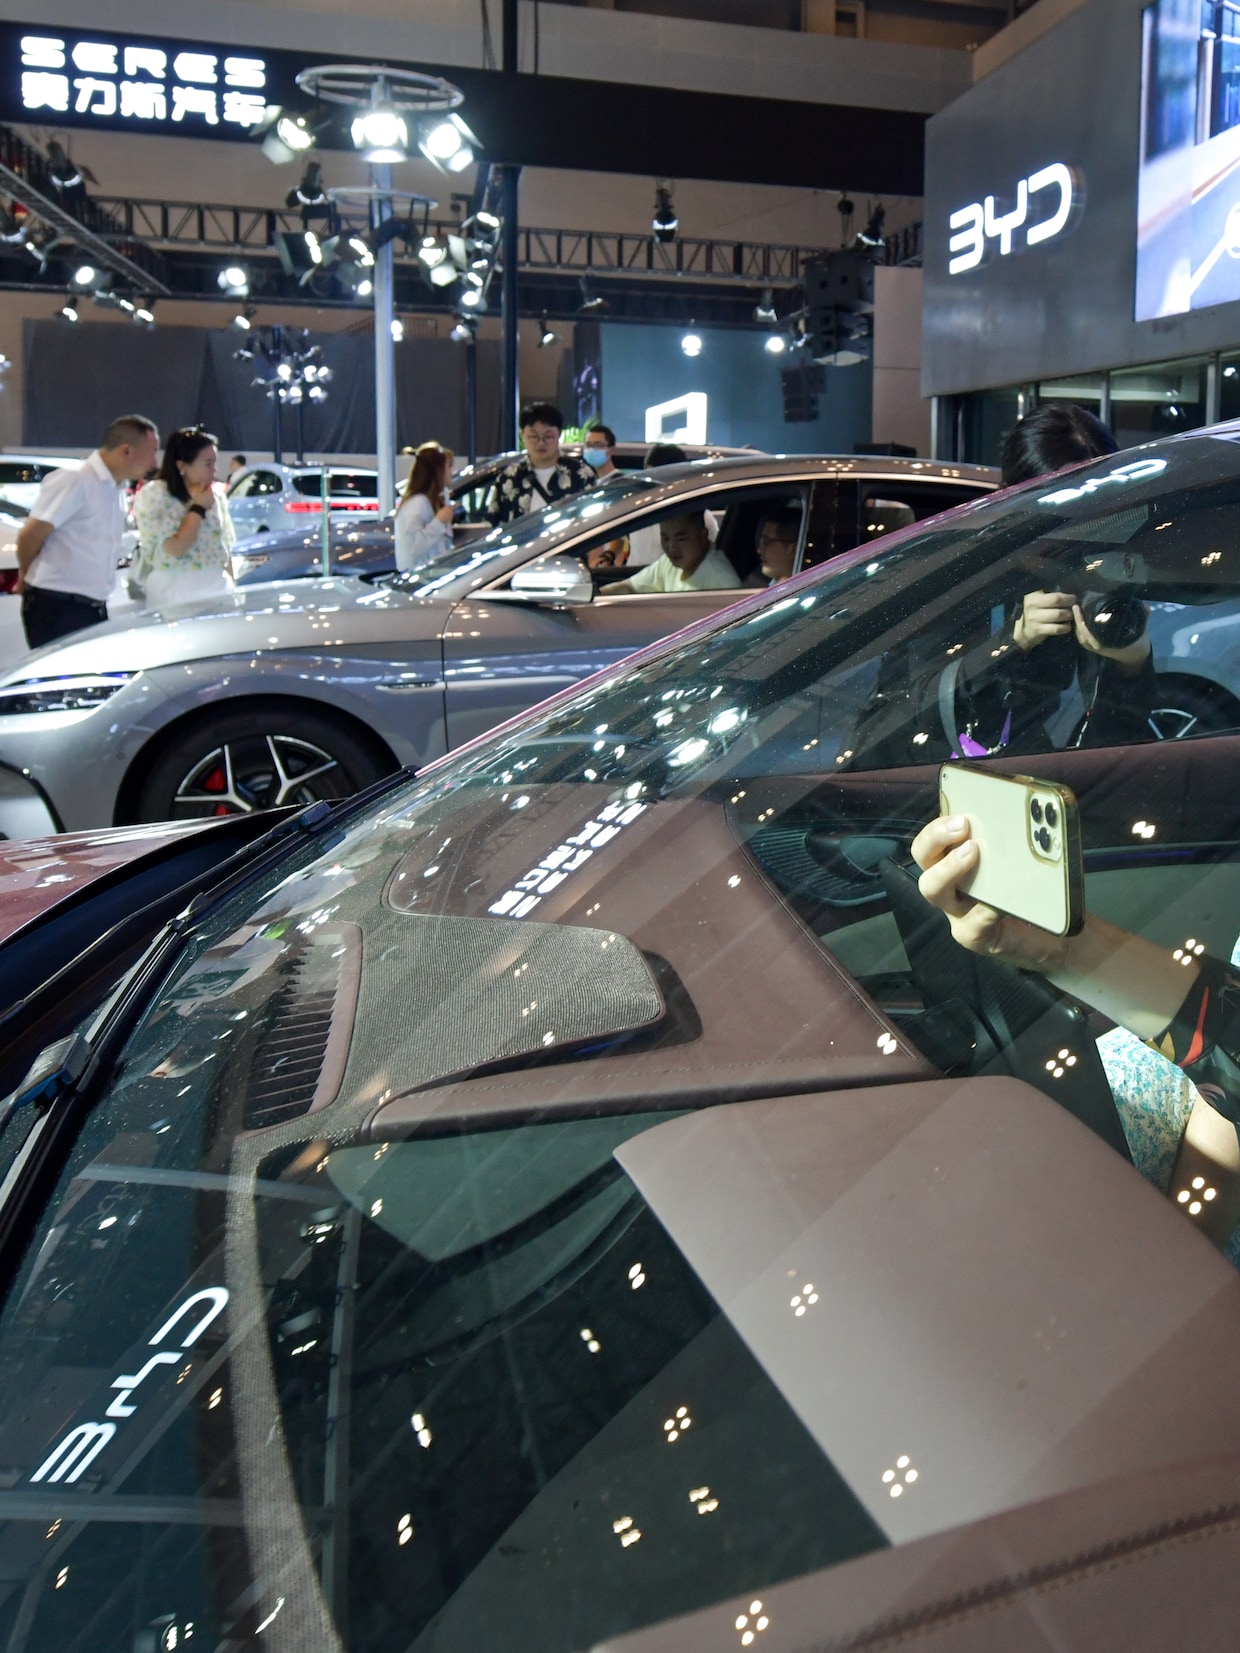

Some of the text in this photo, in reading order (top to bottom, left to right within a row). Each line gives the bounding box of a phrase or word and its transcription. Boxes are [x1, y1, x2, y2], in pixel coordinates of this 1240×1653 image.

[21, 36, 266, 88] SERES
[21, 71, 267, 127] 赛力斯汽车
[948, 162, 1074, 275] BYD
